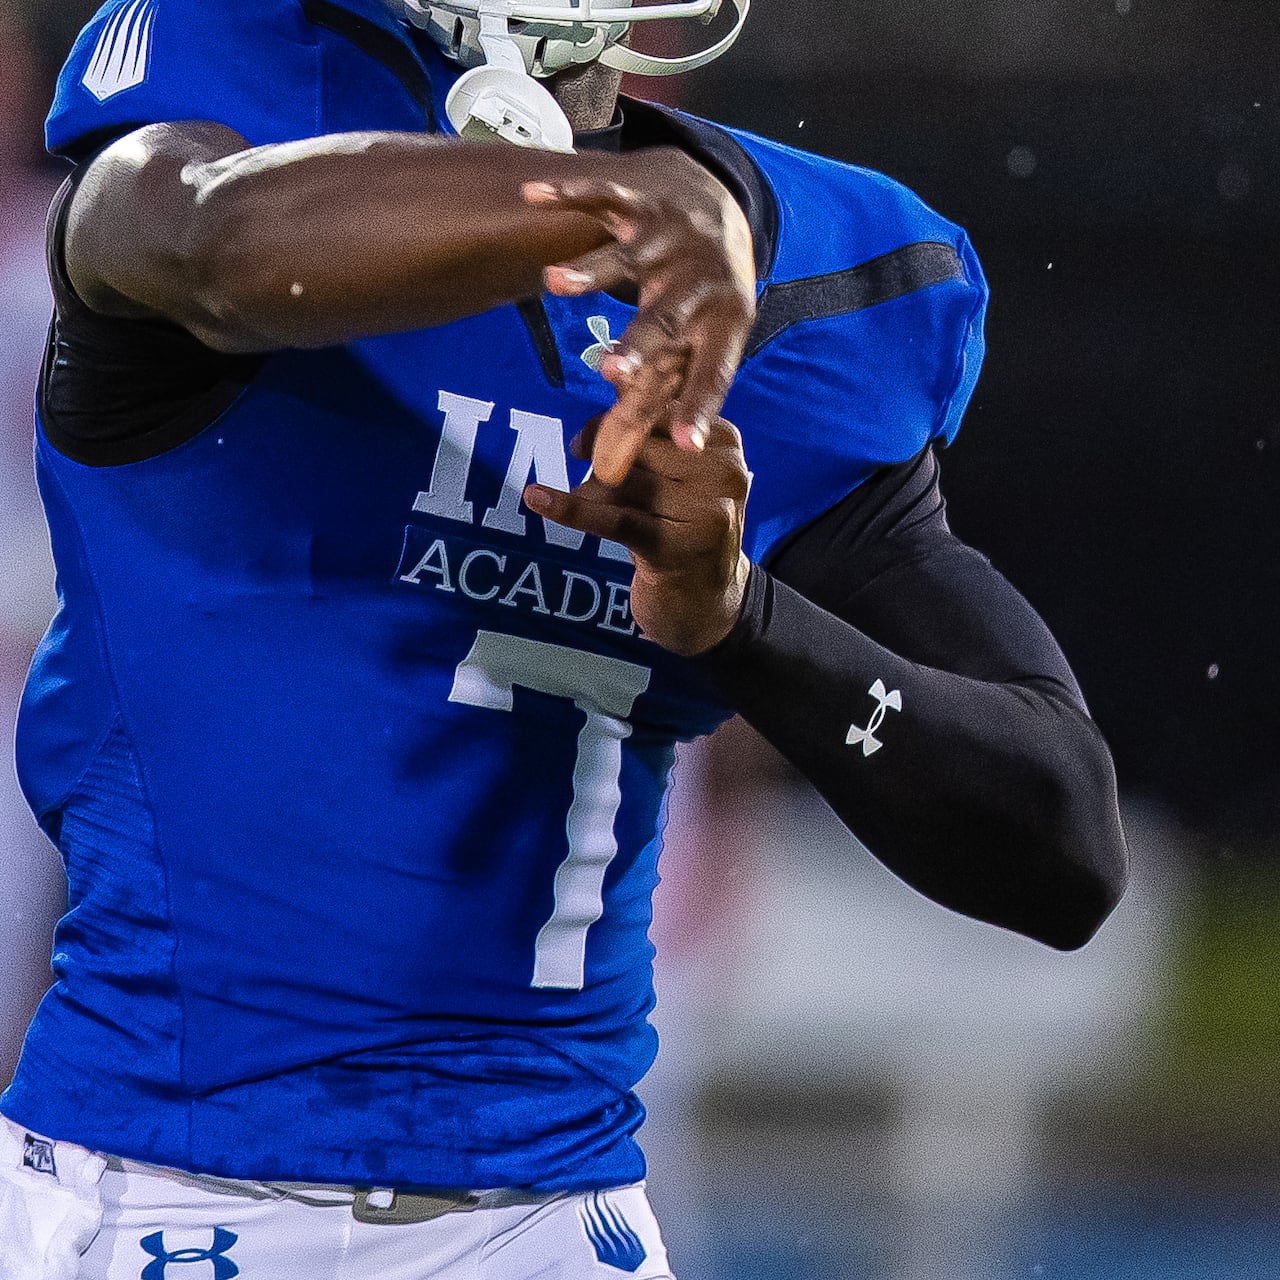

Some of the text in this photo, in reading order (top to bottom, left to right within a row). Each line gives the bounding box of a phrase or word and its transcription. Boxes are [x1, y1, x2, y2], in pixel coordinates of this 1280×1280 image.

[412, 389, 634, 564] IM
[399, 538, 637, 636] ACADE
[447, 629, 652, 990] 7
